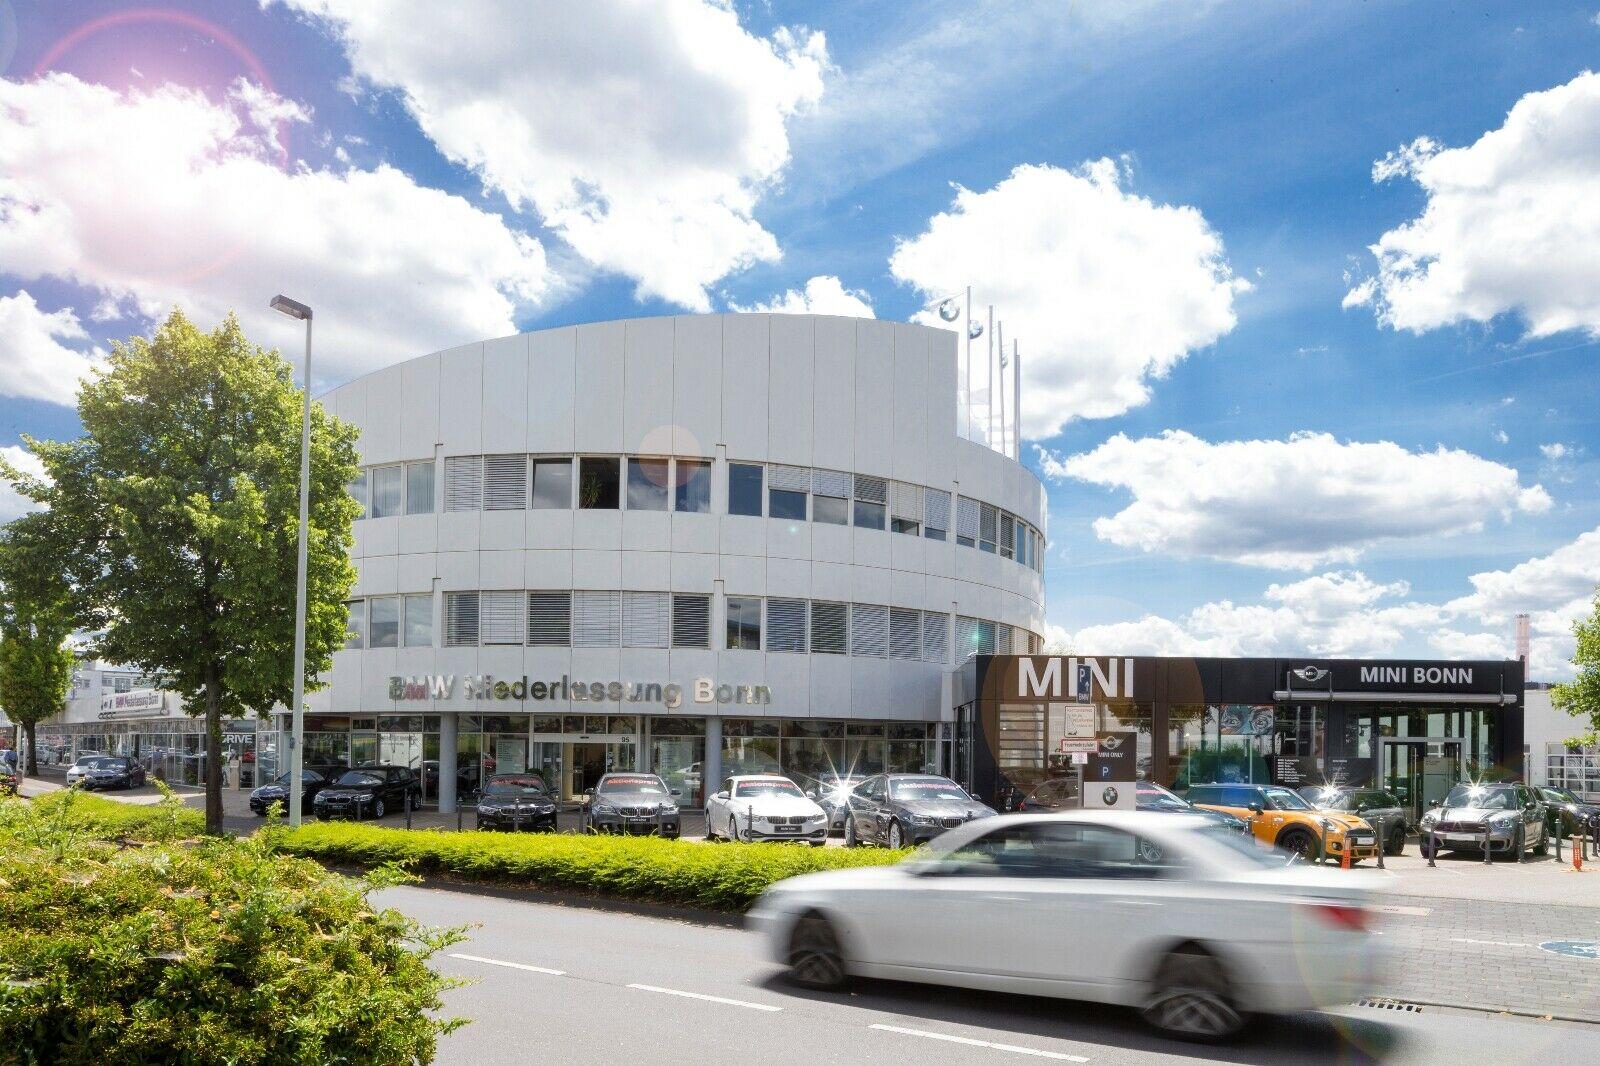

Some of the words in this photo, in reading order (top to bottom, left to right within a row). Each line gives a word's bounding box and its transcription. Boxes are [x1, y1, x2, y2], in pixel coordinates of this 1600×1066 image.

[1018, 657, 1134, 698] MINI
[1079, 668, 1086, 683] P
[1360, 666, 1407, 684] MINI
[1413, 667, 1473, 685] BONN
[388, 674, 455, 700] BMW
[463, 674, 682, 708] Niederlassung
[693, 677, 772, 705] Bonn
[1102, 766, 1109, 777] P
